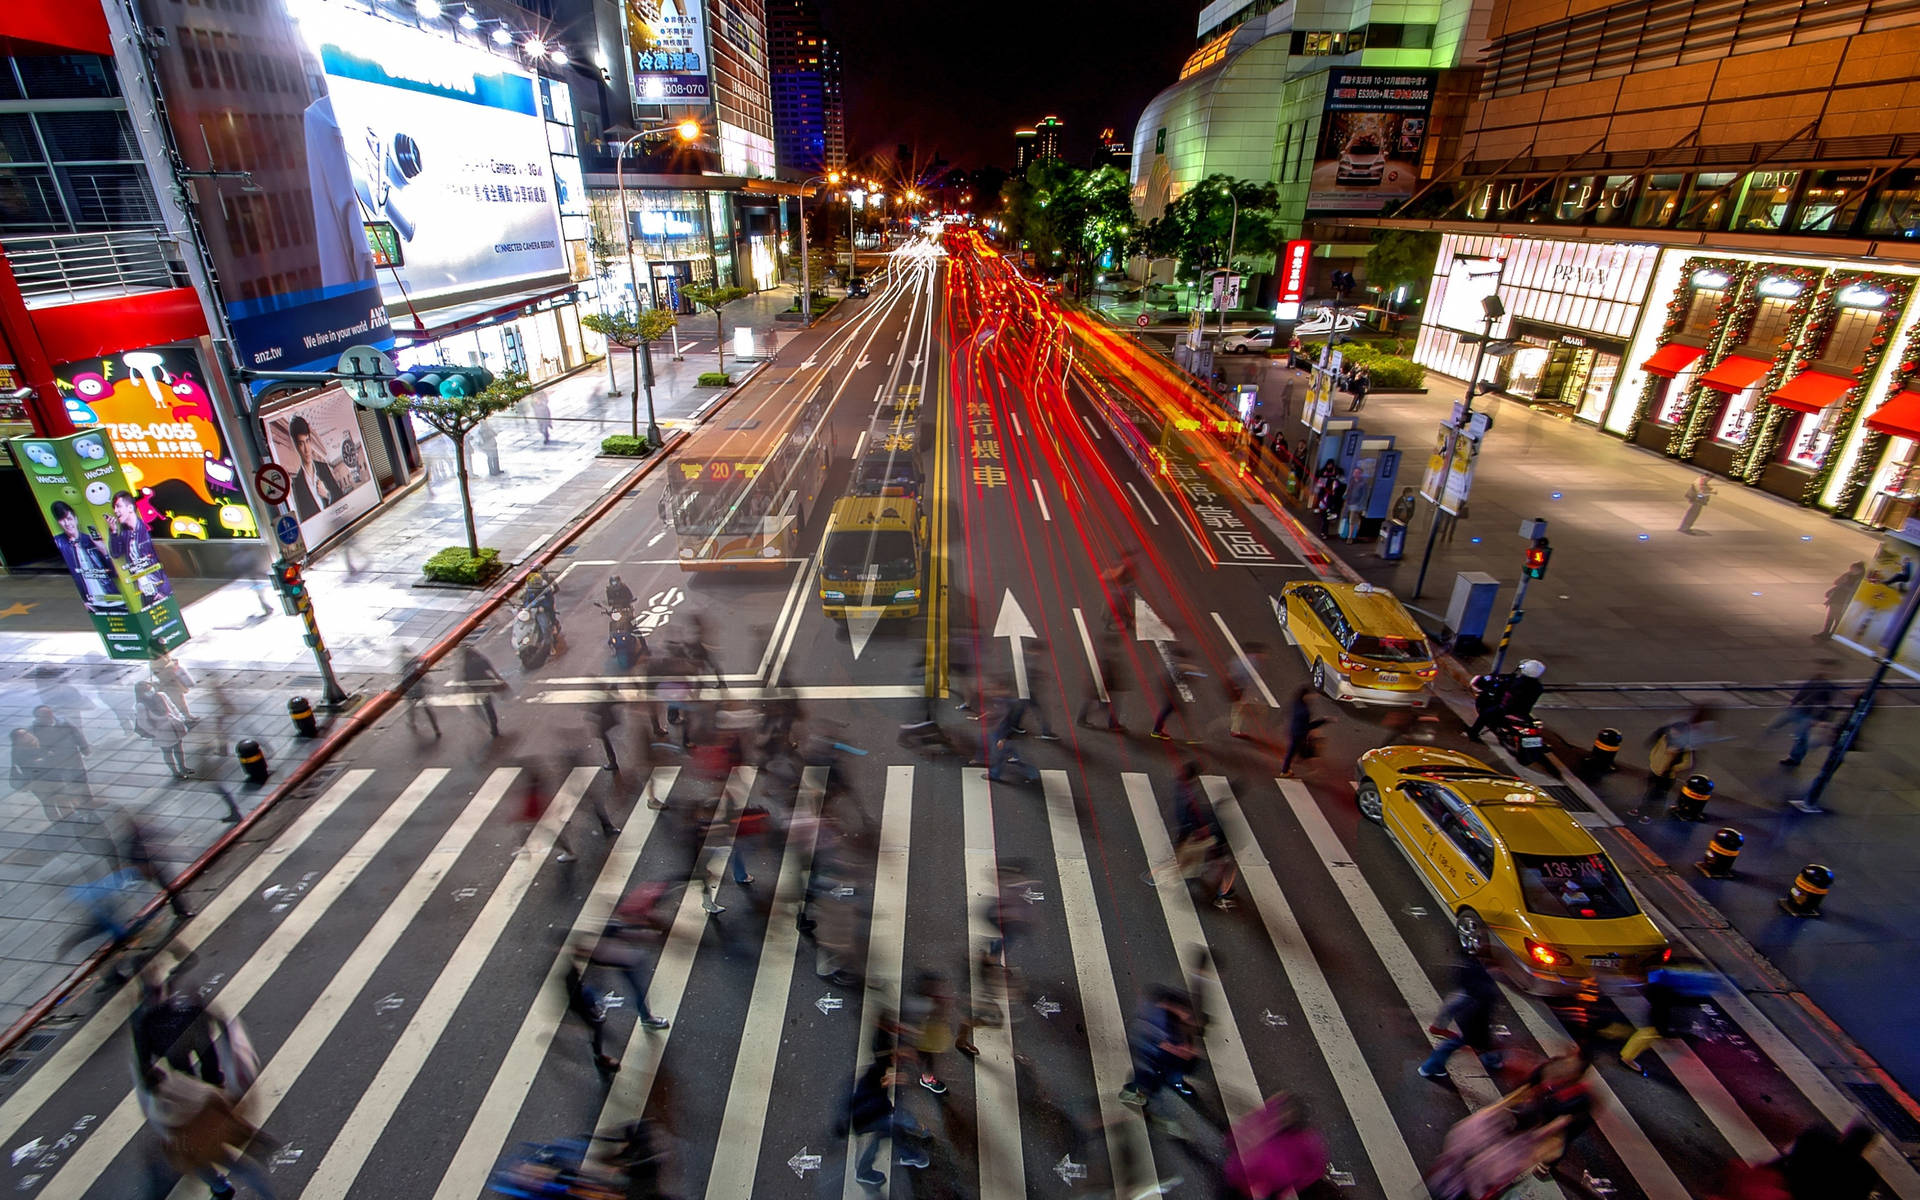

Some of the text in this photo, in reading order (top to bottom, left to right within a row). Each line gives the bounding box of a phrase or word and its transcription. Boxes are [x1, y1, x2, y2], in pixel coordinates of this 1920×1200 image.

[493, 243, 523, 254] CONNECTED
[1552, 264, 1609, 285] PRADA
[370, 305, 388, 329] ANZ
[303, 320, 368, 349] We live in your world
[1561, 335, 1584, 347] PRADA
[253, 347, 283, 365] anz.tw
[97, 422, 197, 440] 758-0055
[36, 475, 69, 484] WeChat
[84, 465, 115, 480] WeChat
[711, 462, 730, 480] 20
